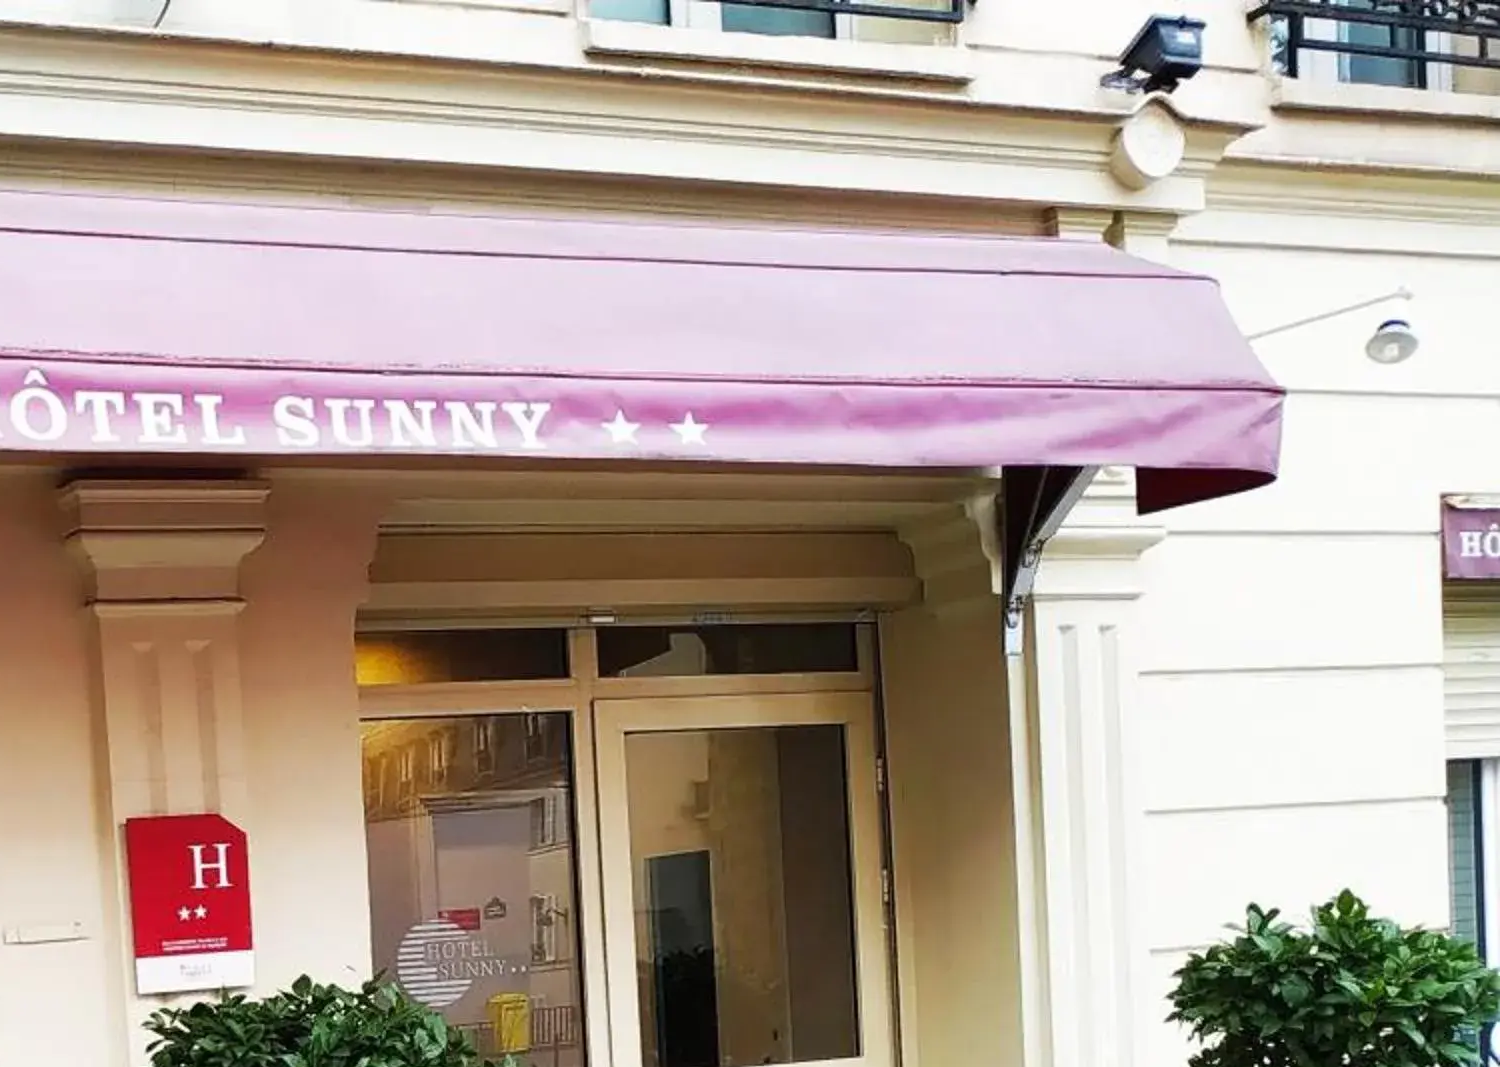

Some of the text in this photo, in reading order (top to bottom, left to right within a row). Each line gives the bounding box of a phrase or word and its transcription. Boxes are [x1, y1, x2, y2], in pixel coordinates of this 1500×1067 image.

[273, 395, 553, 450] SUNNY
[187, 843, 235, 889] H
[438, 959, 507, 979] SUNNY
